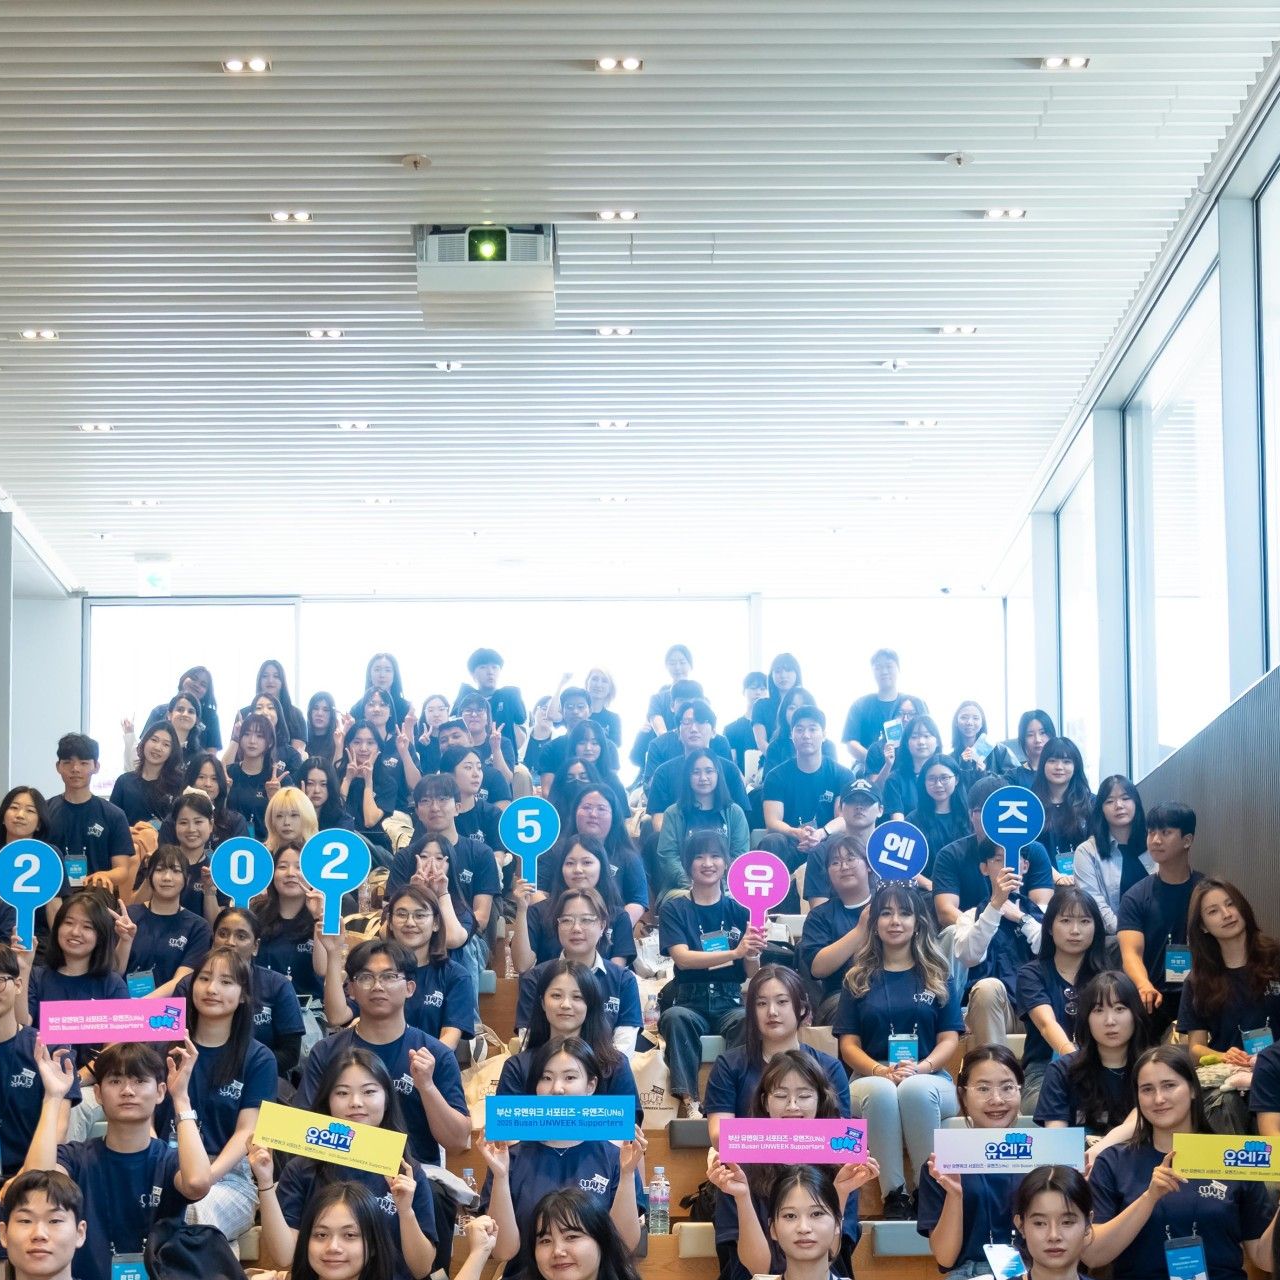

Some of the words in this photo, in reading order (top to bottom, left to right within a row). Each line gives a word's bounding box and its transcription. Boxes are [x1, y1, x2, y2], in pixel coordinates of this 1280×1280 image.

[518, 809, 540, 842] 5
[998, 801, 1027, 834] 즈
[230, 849, 252, 884] 0
[320, 842, 348, 879] 2
[878, 832, 916, 872] 엔
[14, 854, 41, 893] 2
[744, 864, 773, 896] 유
[496, 1108, 512, 1117] 부산
[514, 1108, 543, 1117] 유엔위크
[546, 1108, 575, 1117] 서포터즈
